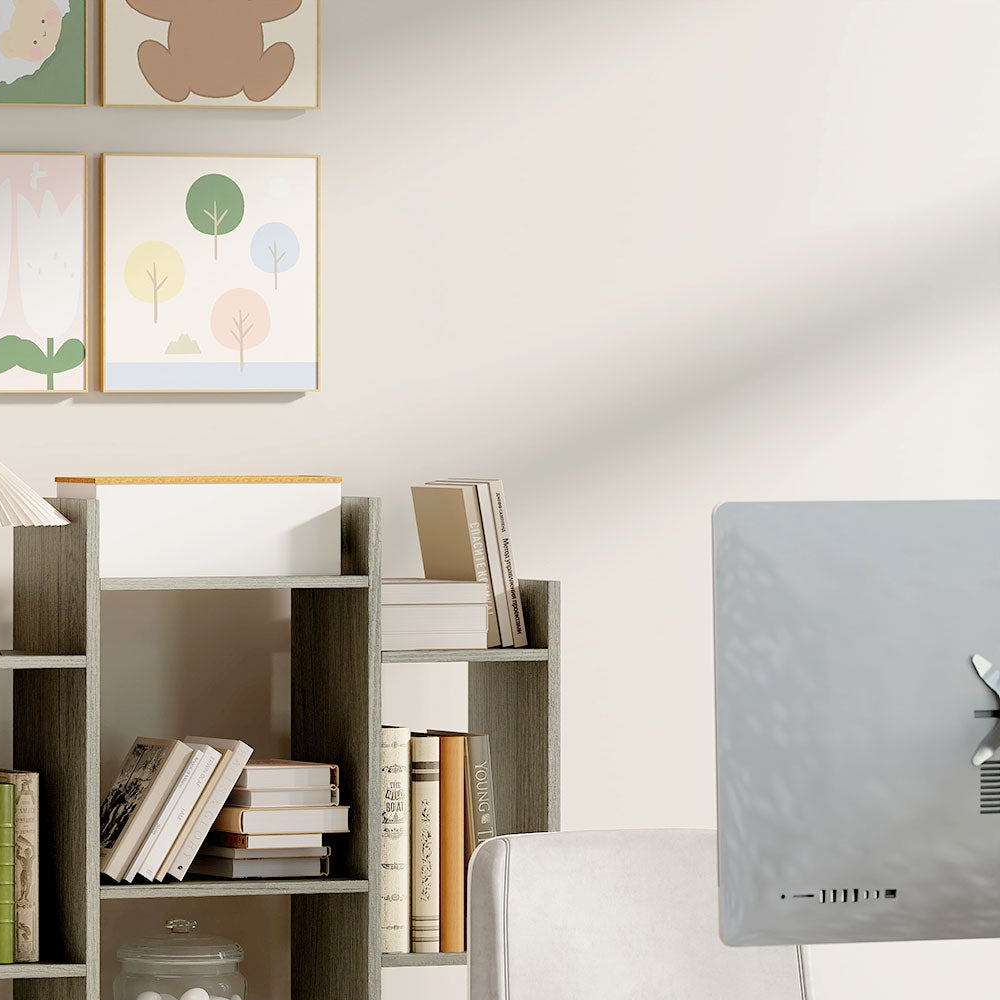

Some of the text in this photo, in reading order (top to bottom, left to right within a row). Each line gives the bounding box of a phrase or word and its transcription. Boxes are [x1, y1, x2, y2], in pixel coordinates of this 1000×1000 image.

[470, 521, 484, 569] СПАСИТЕ
[474, 761, 494, 845] YOUNG T
